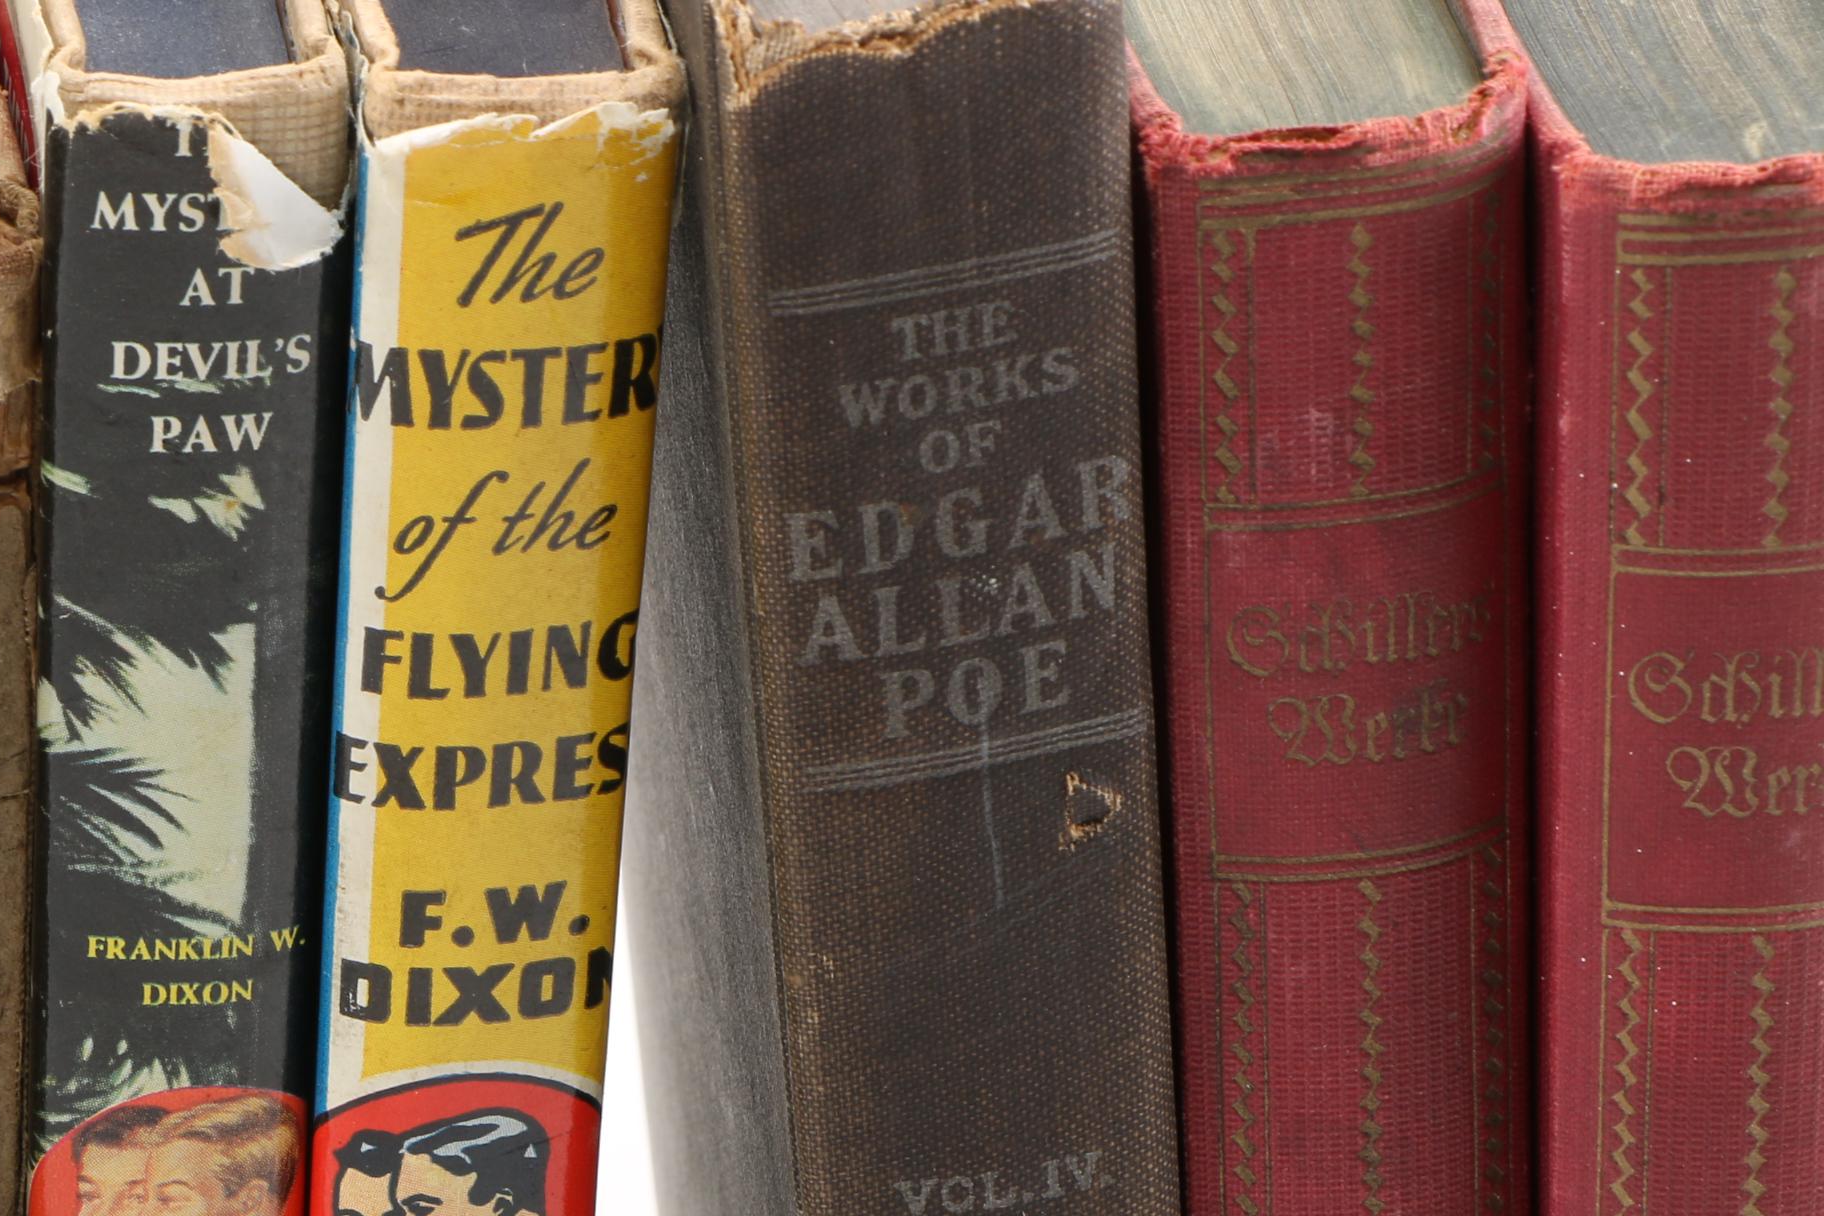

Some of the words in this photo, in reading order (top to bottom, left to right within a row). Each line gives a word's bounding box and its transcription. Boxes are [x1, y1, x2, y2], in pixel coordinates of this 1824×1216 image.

[90, 190, 238, 233] MYST
[179, 267, 255, 306] AT
[455, 201, 605, 308] The
[110, 334, 311, 381] DEVIL'S
[891, 302, 1019, 361] THE
[348, 324, 662, 430] MYSTER
[838, 347, 1079, 429] WORKS
[149, 412, 273, 453] PAW
[919, 420, 1002, 474] OF
[375, 470, 509, 601] of
[492, 457, 617, 556] the
[783, 455, 1129, 583] EDGAR
[797, 541, 1118, 667] ALLAN
[361, 609, 639, 700] FLYING
[878, 640, 1070, 739] POE
[87, 934, 256, 961] FRANKLIN
[270, 924, 306, 952] W.
[399, 880, 590, 949] F.W.
[142, 979, 254, 1006] DIXON
[892, 1171, 1034, 1216] VOL.
[1041, 1151, 1116, 1198] IV.
